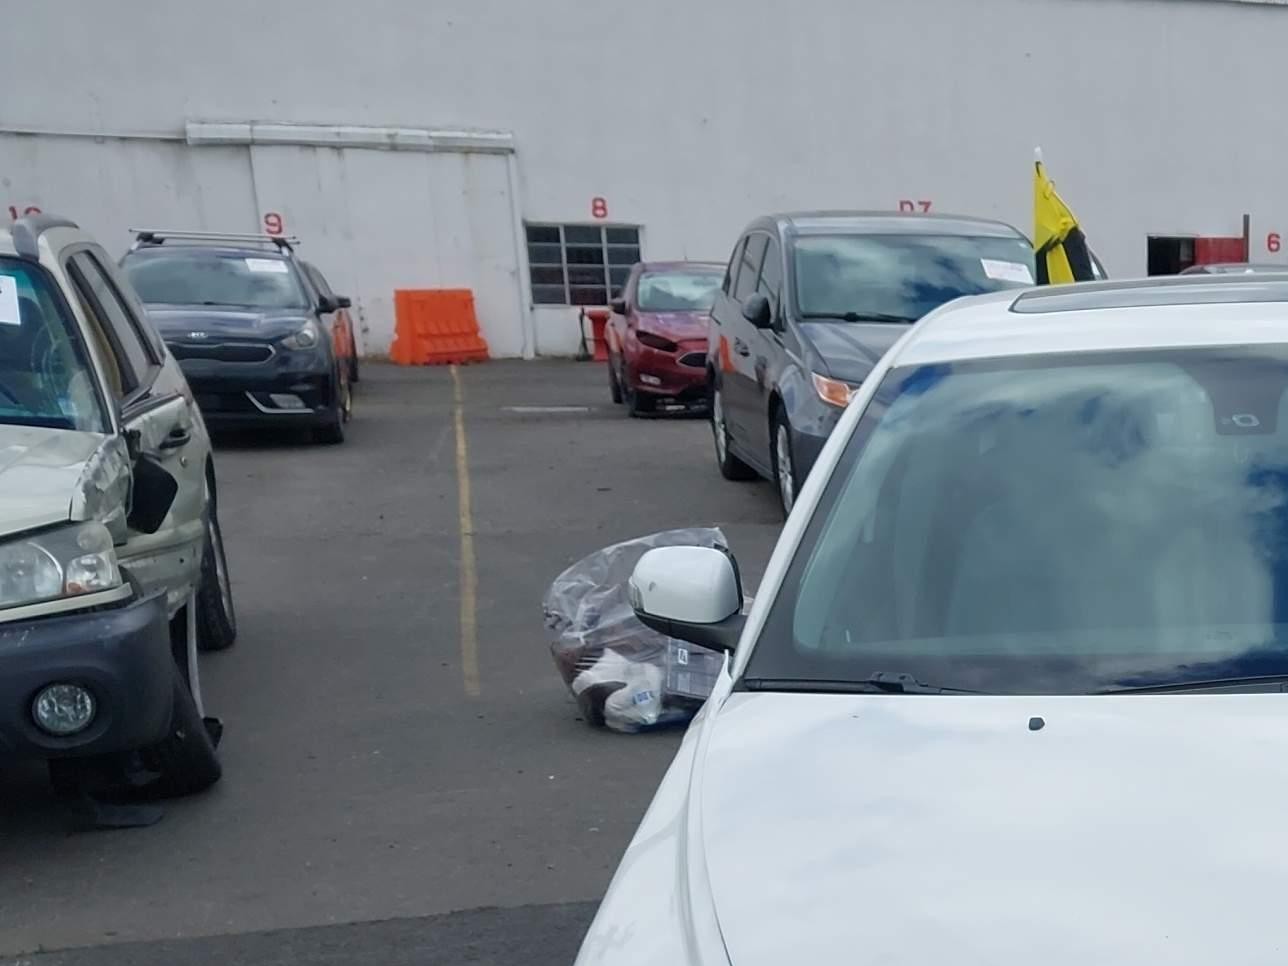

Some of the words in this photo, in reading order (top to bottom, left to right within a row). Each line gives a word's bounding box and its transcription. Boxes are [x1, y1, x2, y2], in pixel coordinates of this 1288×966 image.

[591, 198, 608, 218] 8
[264, 212, 284, 235] 9
[1265, 232, 1281, 253] 6
